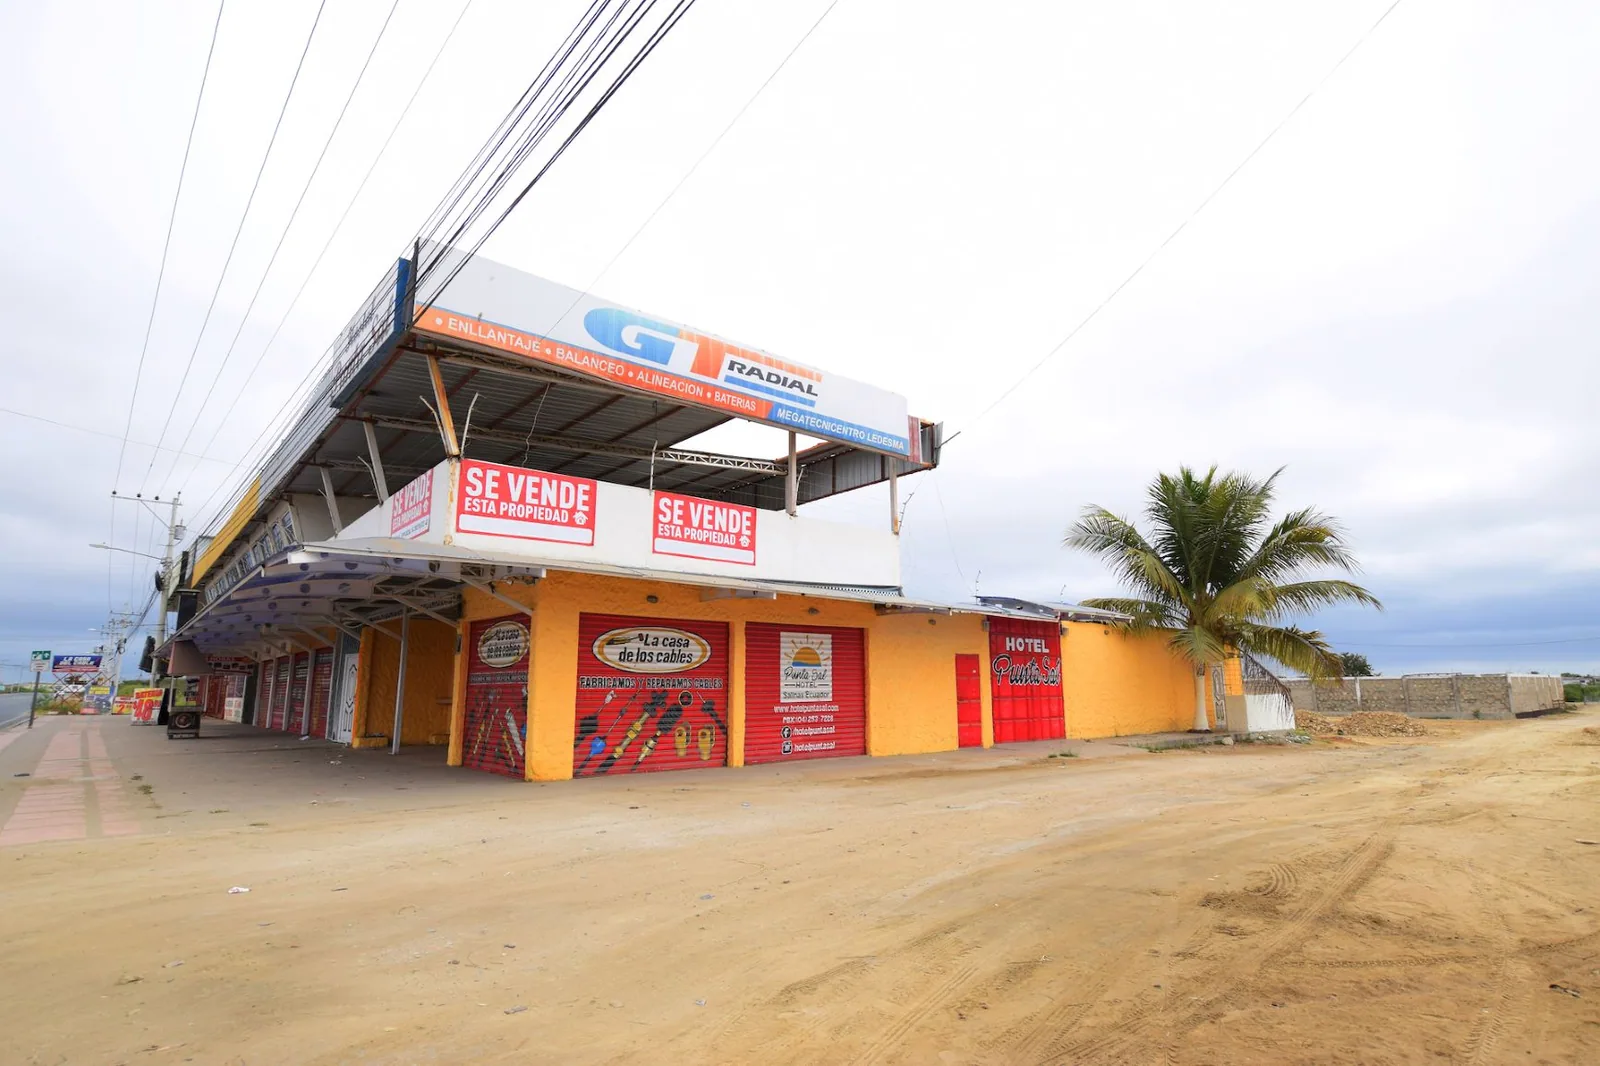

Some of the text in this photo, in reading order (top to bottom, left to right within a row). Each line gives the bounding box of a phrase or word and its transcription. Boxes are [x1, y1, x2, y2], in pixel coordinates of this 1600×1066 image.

[447, 317, 756, 412] ENLLANTAJE BALANCEO ALINEACION BATERIAS
[727, 359, 818, 397] RADIAL
[777, 408, 905, 451] MEGATECNICENTRO LEDESMA
[464, 465, 590, 512] SE VENDE
[464, 496, 569, 524] ESTA PROPIEDAD
[658, 498, 752, 536] SE VENDE
[658, 523, 736, 546] ESTA PROPIEDAD
[643, 634, 690, 648] La casa
[1006, 637, 1050, 653] HOTEL
[618, 647, 693, 664] de los cables
[580, 676, 723, 689] FABRICAMOS Y REPARAMOS CABLES
[783, 666, 809, 681] Punta
[992, 654, 1041, 686] Punta
[805, 690, 830, 699] Ecuador
